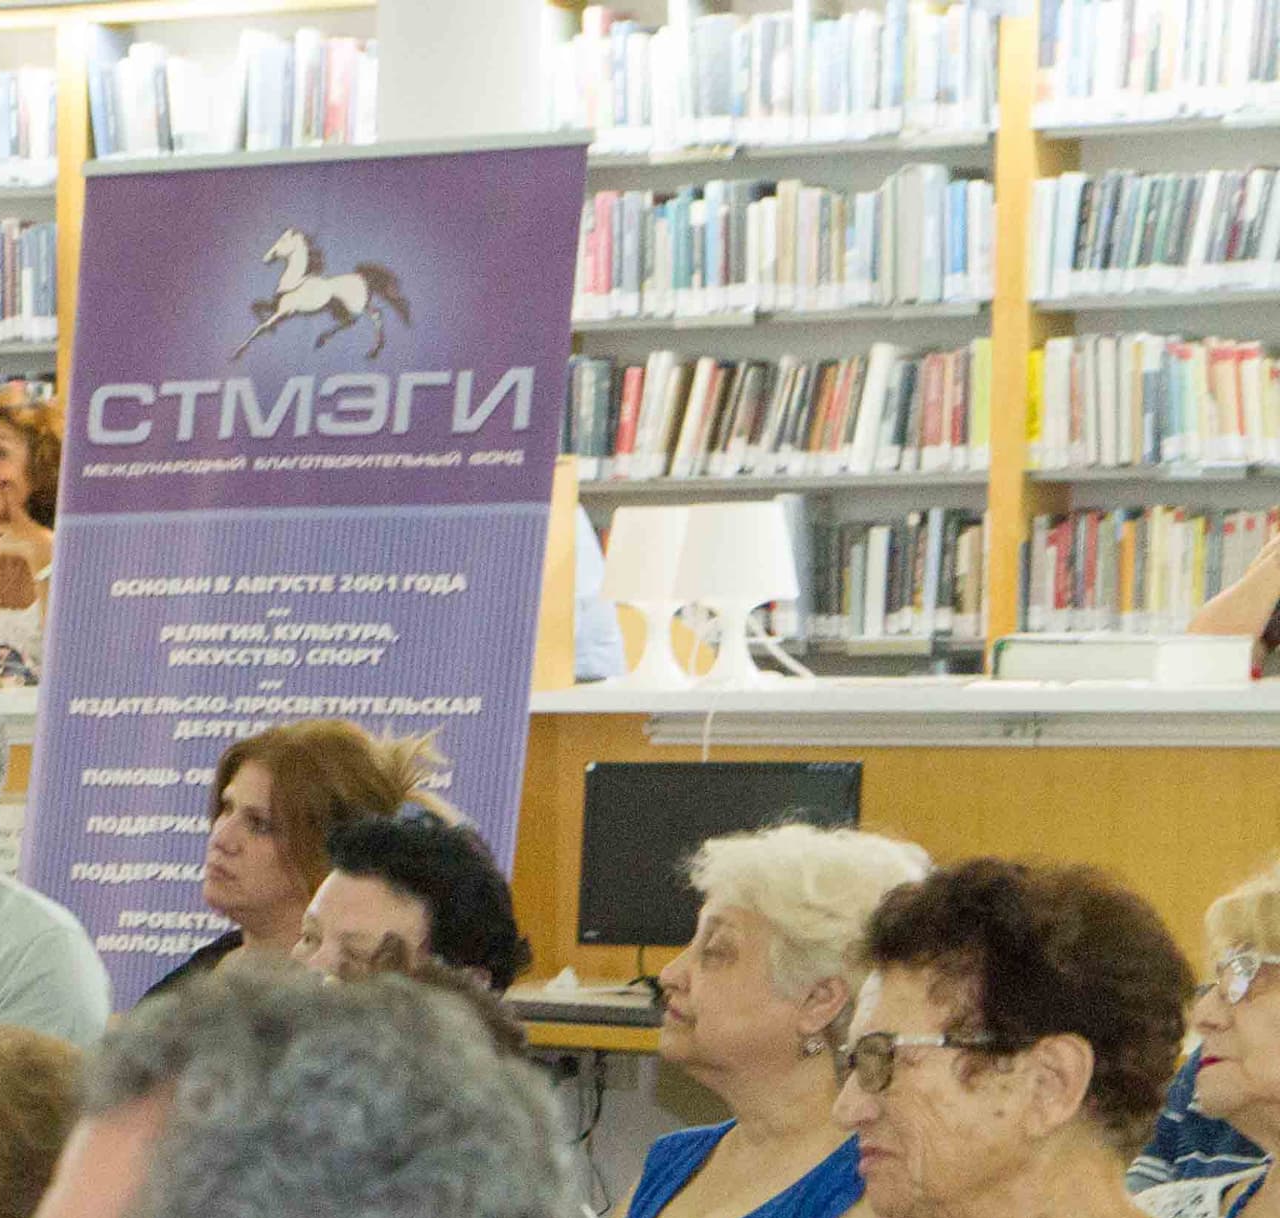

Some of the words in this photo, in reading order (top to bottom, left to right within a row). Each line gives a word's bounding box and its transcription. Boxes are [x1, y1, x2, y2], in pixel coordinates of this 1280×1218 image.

[87, 366, 535, 445] СТМЭГИ
[82, 454, 247, 478] МЕЖДУНАРОДНЫЙ
[467, 449, 525, 467] ФОНД
[110, 575, 213, 598] ОСНОВАН
[211, 575, 232, 595] В
[233, 573, 336, 595] АВГУСТЕ
[340, 573, 399, 594] 2001
[402, 571, 468, 596] ГОДА
[272, 622, 400, 645] КУЛЬТУРА,
[168, 648, 304, 669] ИСКУССТВО,
[305, 647, 387, 666] СПОРТ
[81, 767, 181, 788] ПОМОЩЬ
[86, 815, 211, 837] ПОДДЕРЖК
